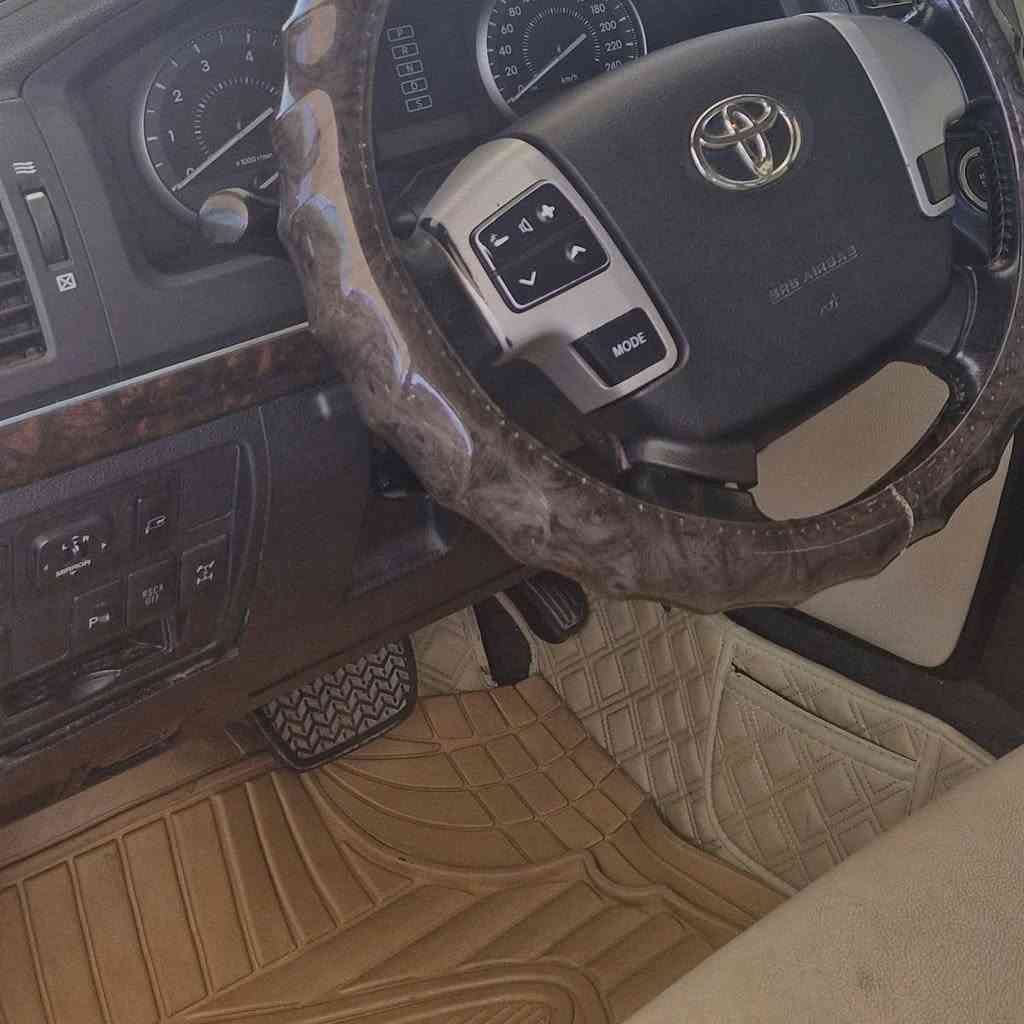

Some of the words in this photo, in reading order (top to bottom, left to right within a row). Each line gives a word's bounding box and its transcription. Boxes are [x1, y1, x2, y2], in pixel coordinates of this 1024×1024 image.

[508, 5, 522, 17] 80
[590, 2, 606, 16] 180
[500, 22, 514, 35] 60
[600, 20, 617, 33] 200
[498, 44, 512, 56] 40
[604, 39, 623, 53] 220
[200, 60, 211, 73] 3
[504, 64, 518, 77] 20
[172, 89, 184, 104] 2
[167, 129, 176, 143] 1
[612, 331, 648, 359] MODE
